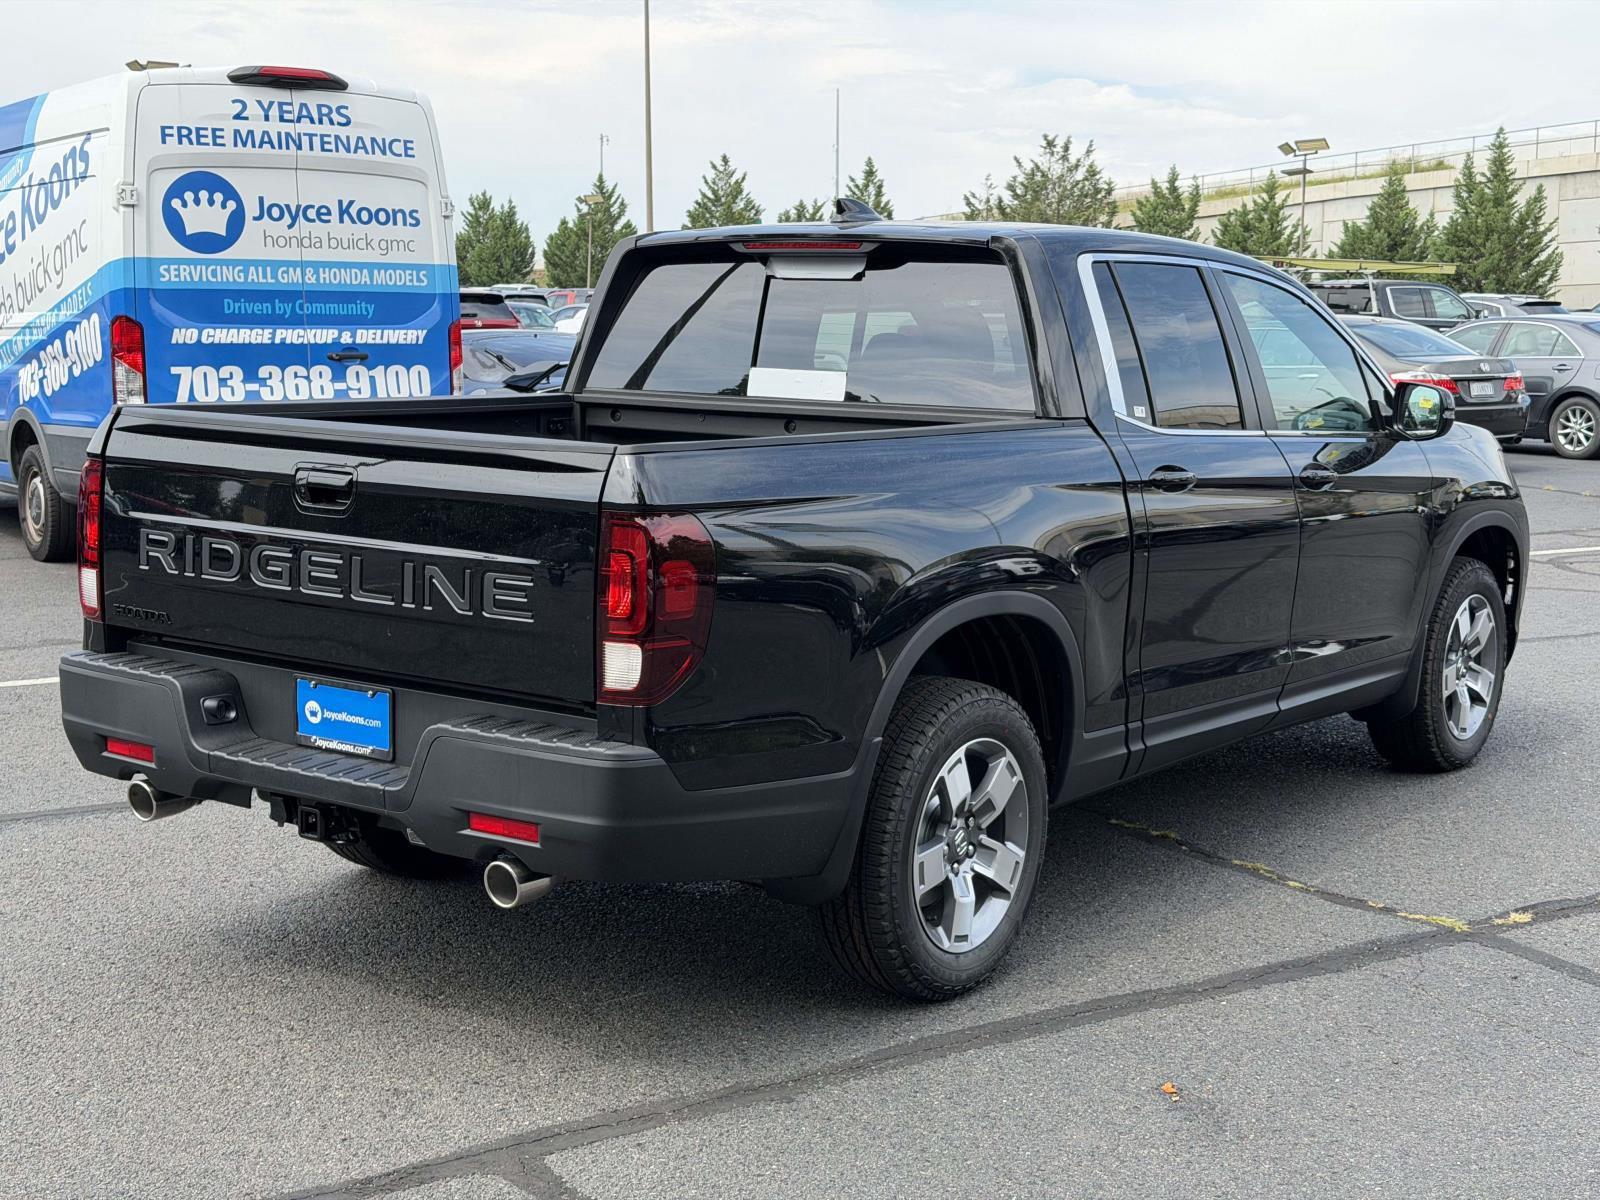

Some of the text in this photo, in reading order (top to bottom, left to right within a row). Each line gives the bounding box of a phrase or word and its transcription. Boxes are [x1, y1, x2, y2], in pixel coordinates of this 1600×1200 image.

[230, 98, 352, 127] 2 YEARS
[160, 125, 416, 159] FREE MAINTENANCE
[21, 132, 92, 242] Koons
[252, 195, 421, 231] Joyce Koons
[263, 229, 416, 256] honda buick gmc
[13, 244, 52, 313] buick
[53, 218, 88, 290] gmc
[159, 265, 428, 287] SERVICING ALL GM & HONDA MODELS
[224, 298, 375, 318] Driven by Community
[171, 328, 428, 344] NO CHARGE PICKUP & DELIVERY
[18, 313, 102, 405] 703-368-9100
[170, 365, 431, 402] 703-368-9100
[138, 528, 535, 623] RIDGELINE
[323, 708, 382, 728] JoyceKoons.com
[314, 738, 371, 755] JoyceKoons.com
